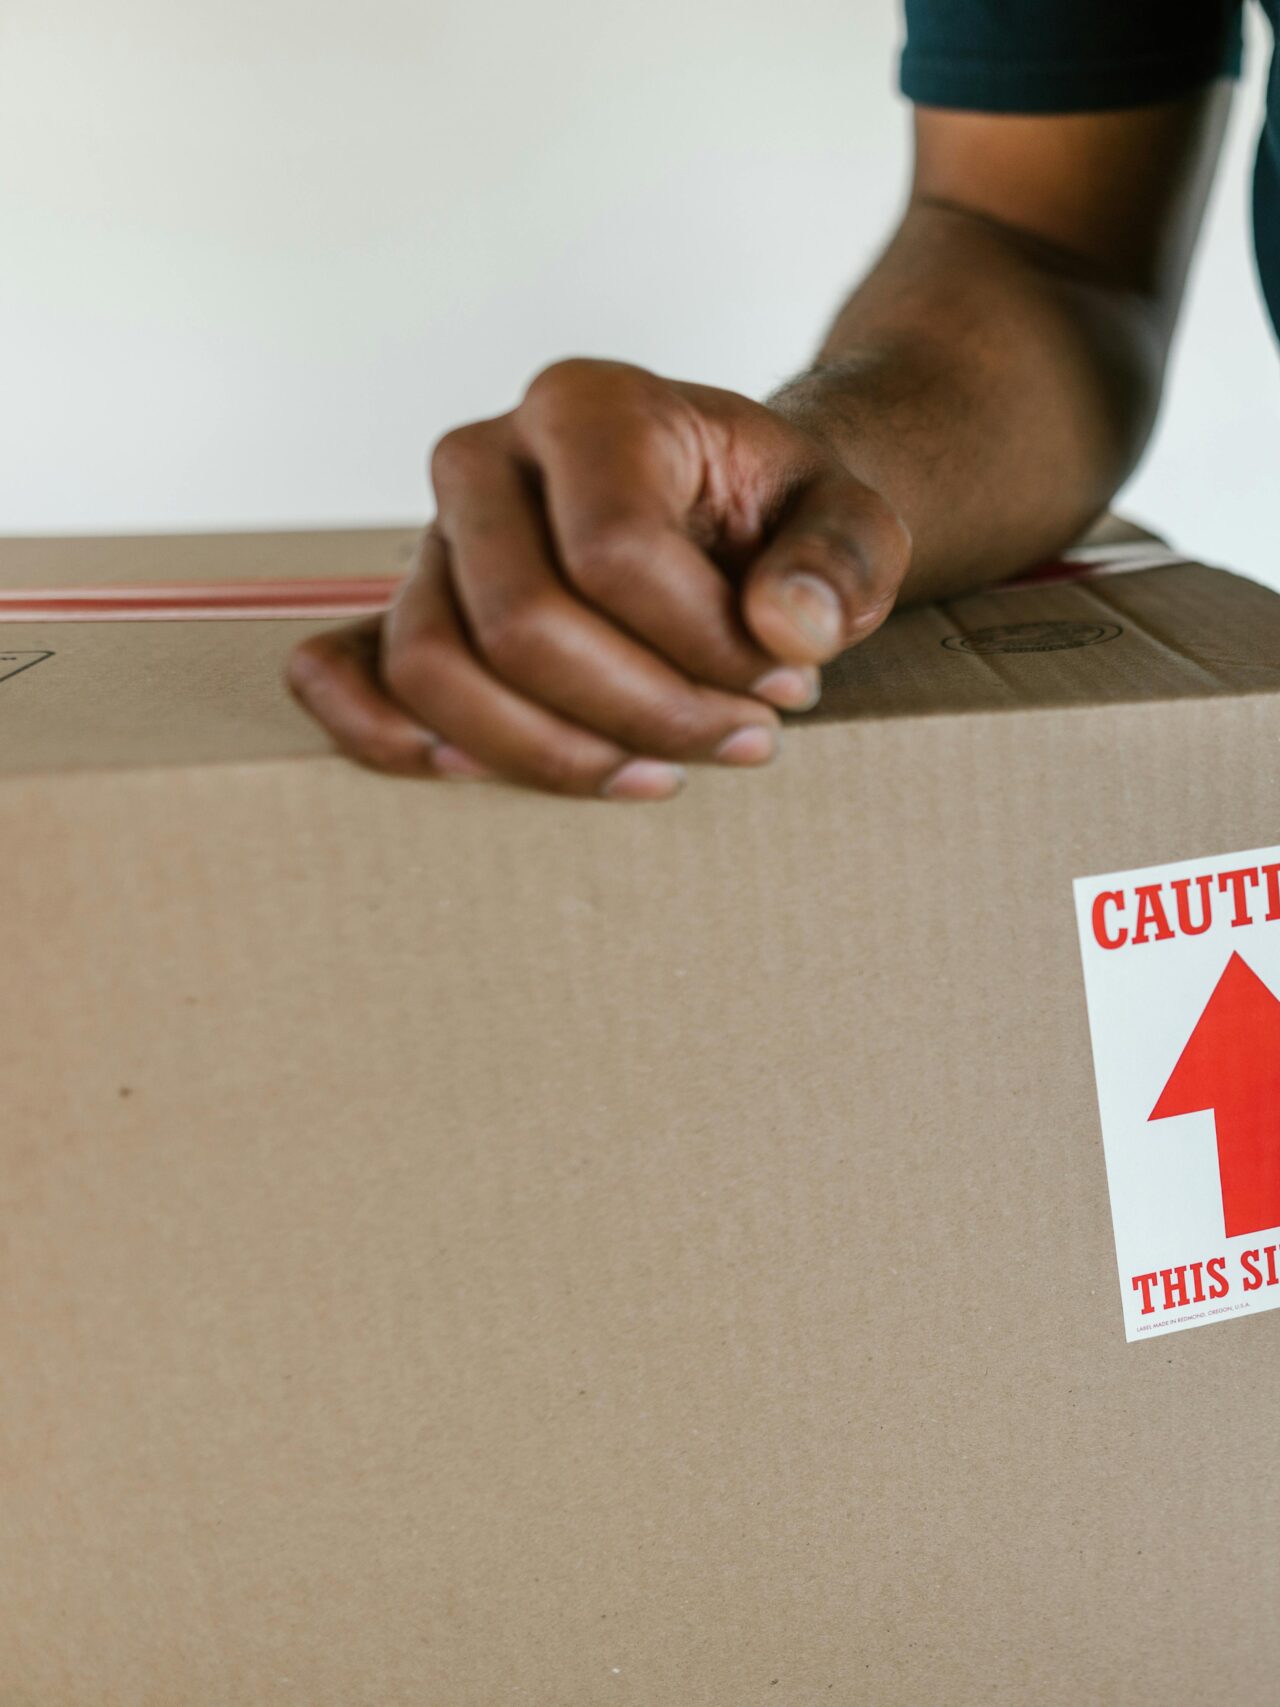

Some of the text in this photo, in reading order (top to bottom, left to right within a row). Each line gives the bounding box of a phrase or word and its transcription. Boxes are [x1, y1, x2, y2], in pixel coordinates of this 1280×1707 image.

[1131, 1256, 1230, 1315] THIS
[1137, 1324, 1152, 1332] LABEL
[1153, 1320, 1169, 1328] MADE
